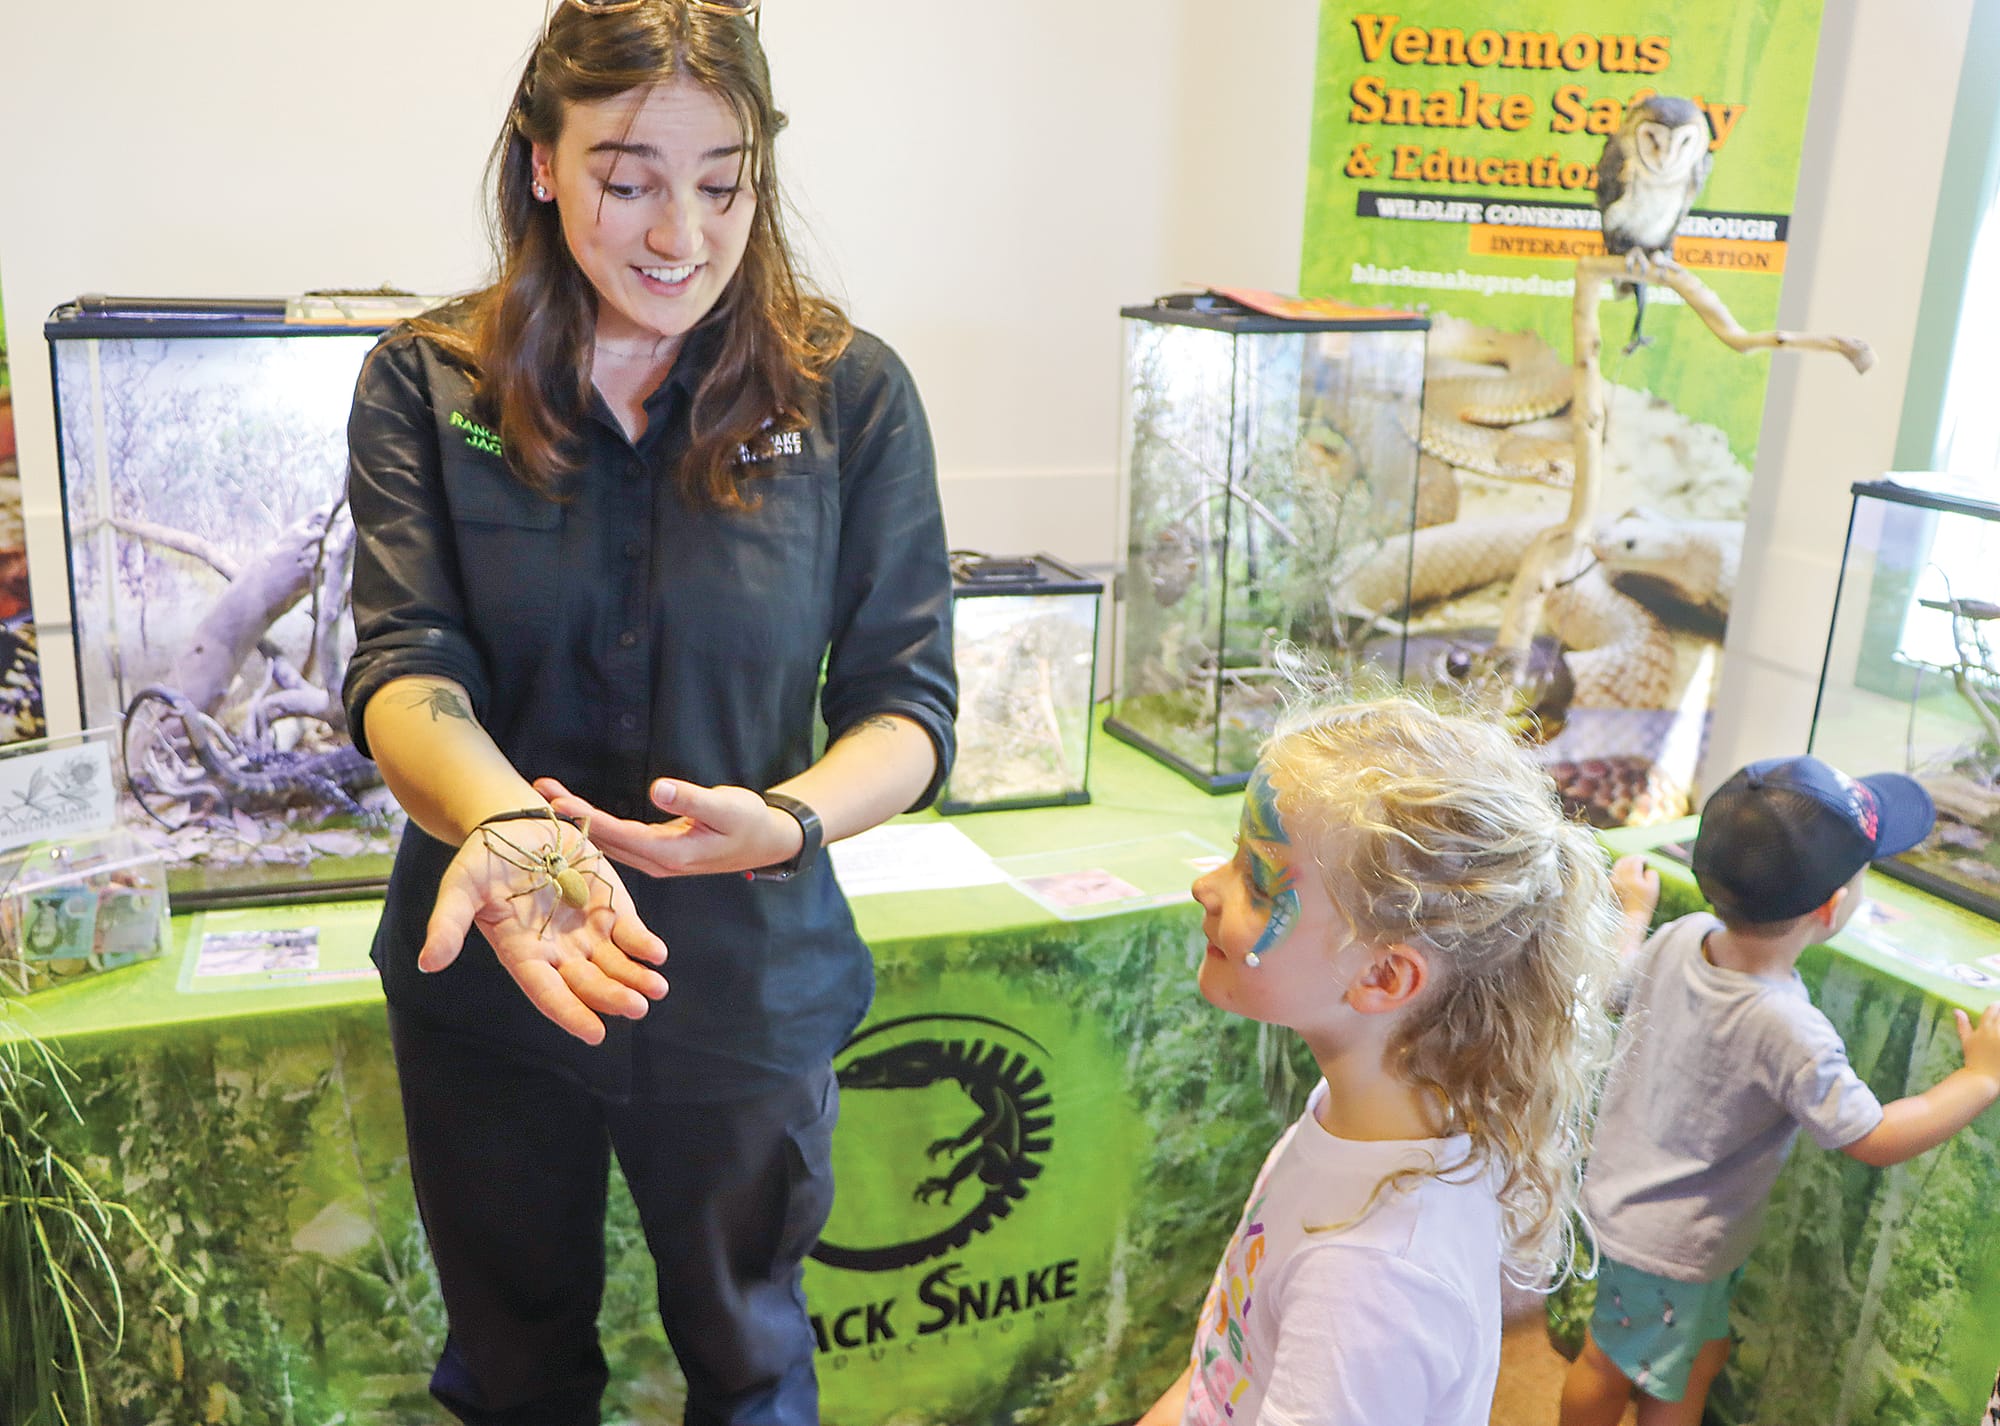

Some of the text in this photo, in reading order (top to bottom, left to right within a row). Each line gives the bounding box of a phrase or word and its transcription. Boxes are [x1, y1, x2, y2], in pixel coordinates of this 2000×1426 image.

[1352, 14, 1671, 73] Venomous
[1350, 75, 1746, 152] Snake Say
[1345, 143, 1381, 178] &
[1376, 198, 1778, 242] WILDLIFE CONSERVA HROUGH
[1675, 248, 1770, 268] CATION
[810, 1298, 898, 1354] ACK
